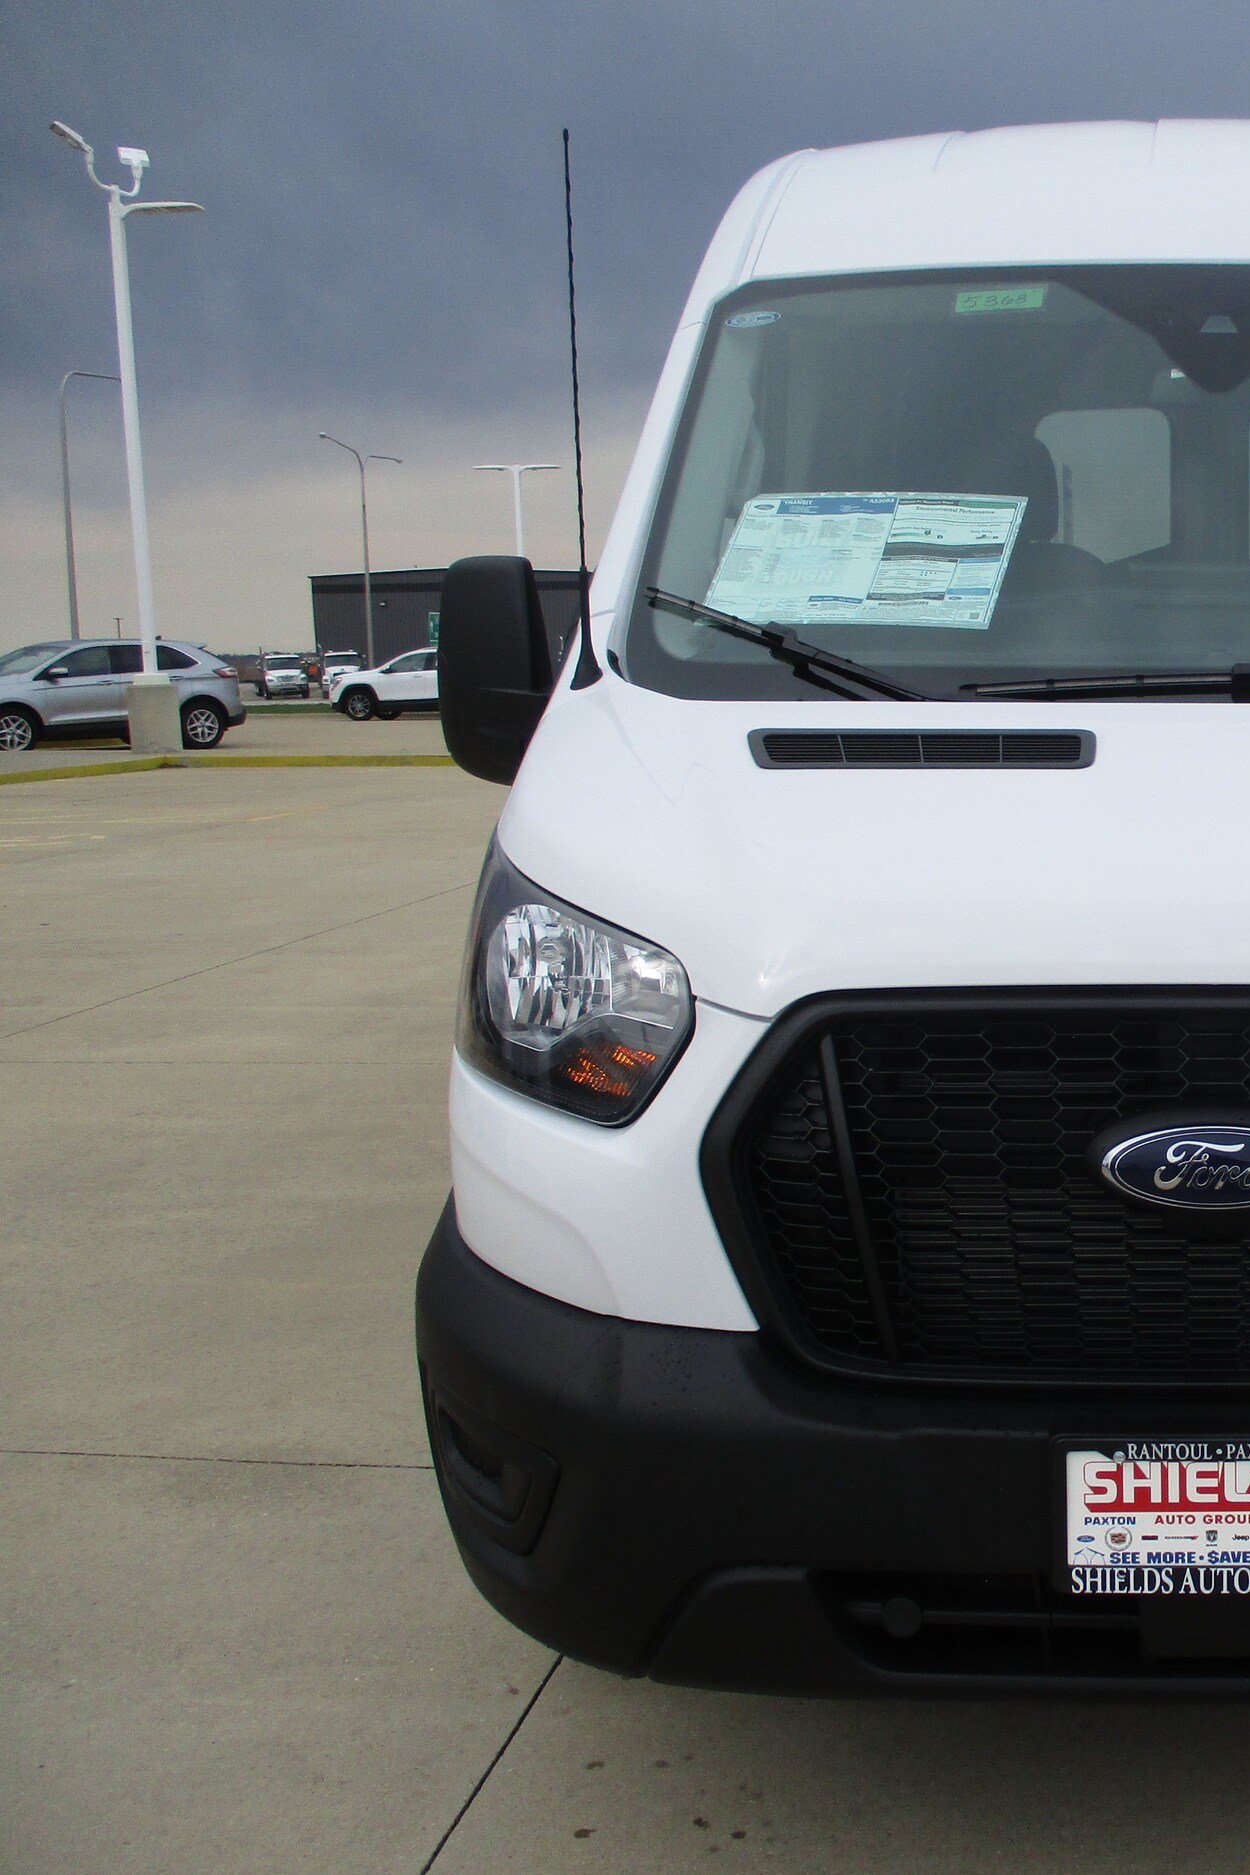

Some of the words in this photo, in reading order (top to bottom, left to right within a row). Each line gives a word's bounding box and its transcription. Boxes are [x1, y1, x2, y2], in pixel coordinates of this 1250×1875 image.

[1127, 1443, 1212, 1460] RANTOUL
[1084, 1516, 1136, 1525] PAXTON
[1155, 1514, 1196, 1524] AUTO
[1231, 1533, 1250, 1541] Jeep
[1109, 1551, 1140, 1564] SEE
[1146, 1551, 1197, 1564] MORE
[1071, 1566, 1174, 1594] SHIELDS
